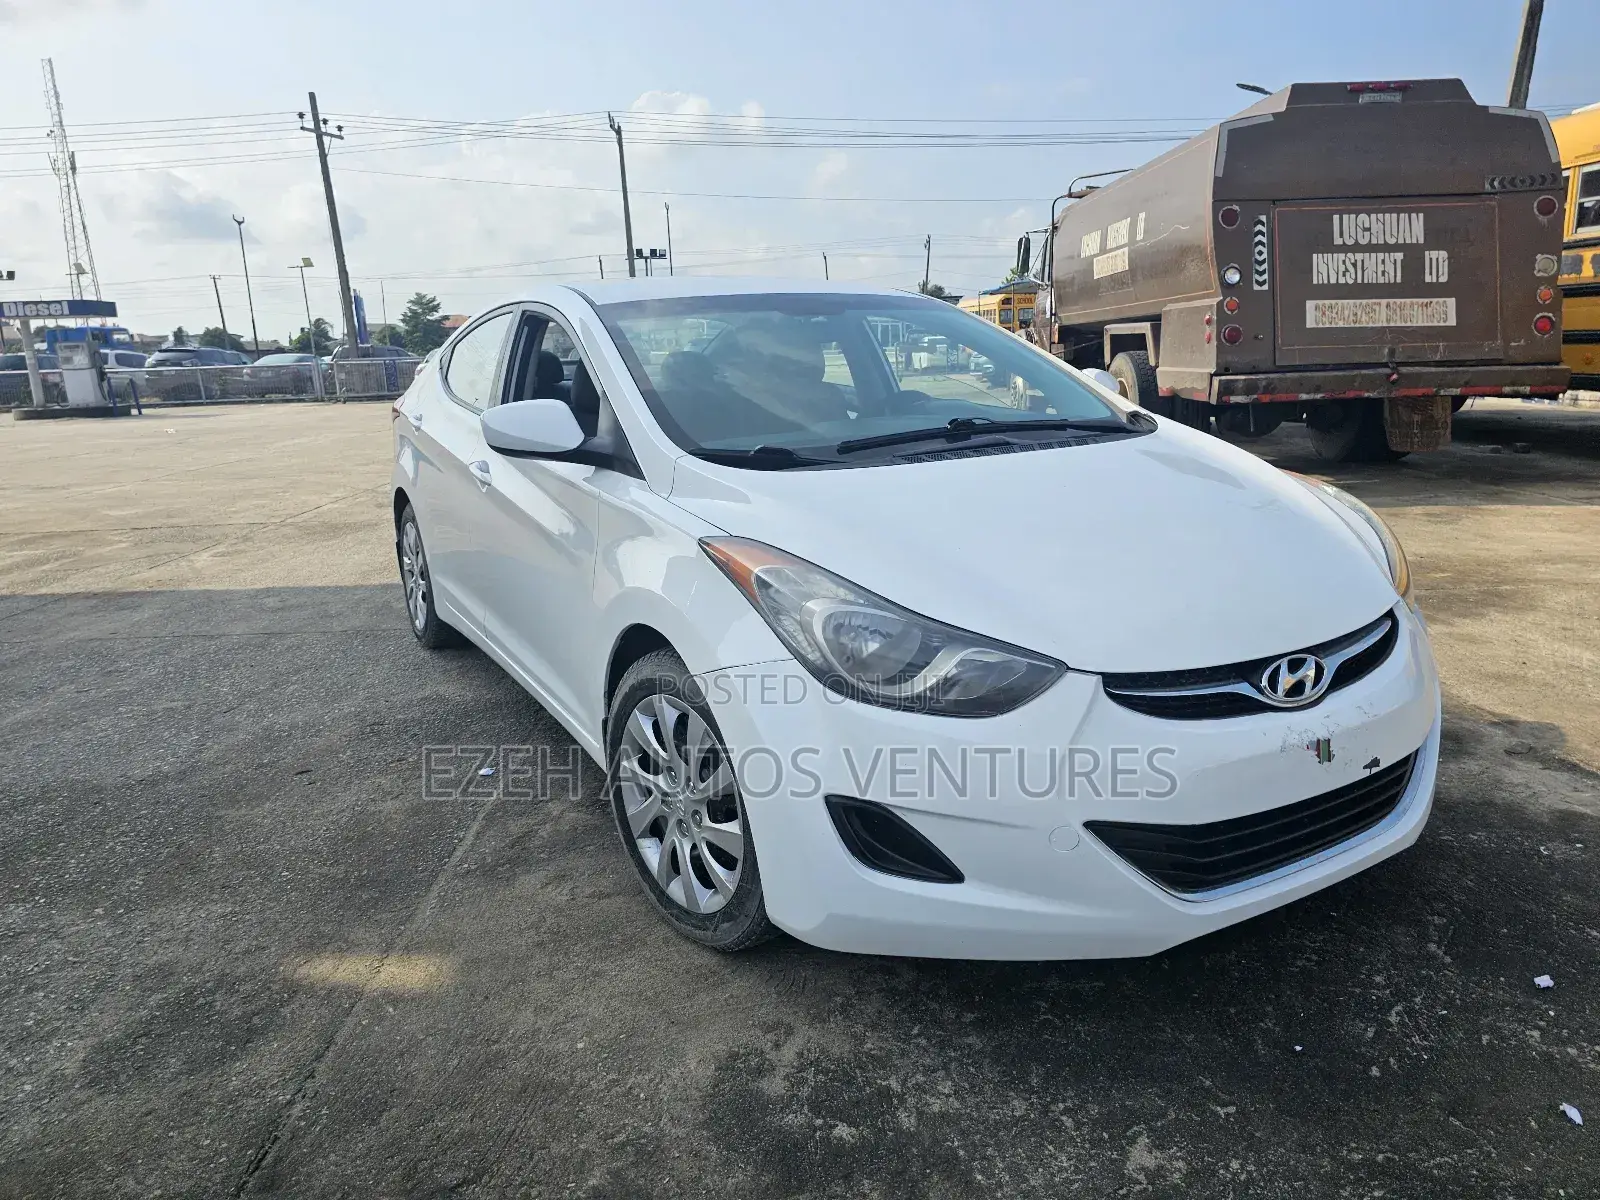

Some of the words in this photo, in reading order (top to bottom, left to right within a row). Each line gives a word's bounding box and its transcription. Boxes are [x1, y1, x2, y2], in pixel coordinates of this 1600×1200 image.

[1333, 213, 1424, 245] LUCHUAN
[1313, 252, 1404, 284] INVESTMENT
[1425, 250, 1448, 283] LTD
[3, 301, 70, 317] Diesel
